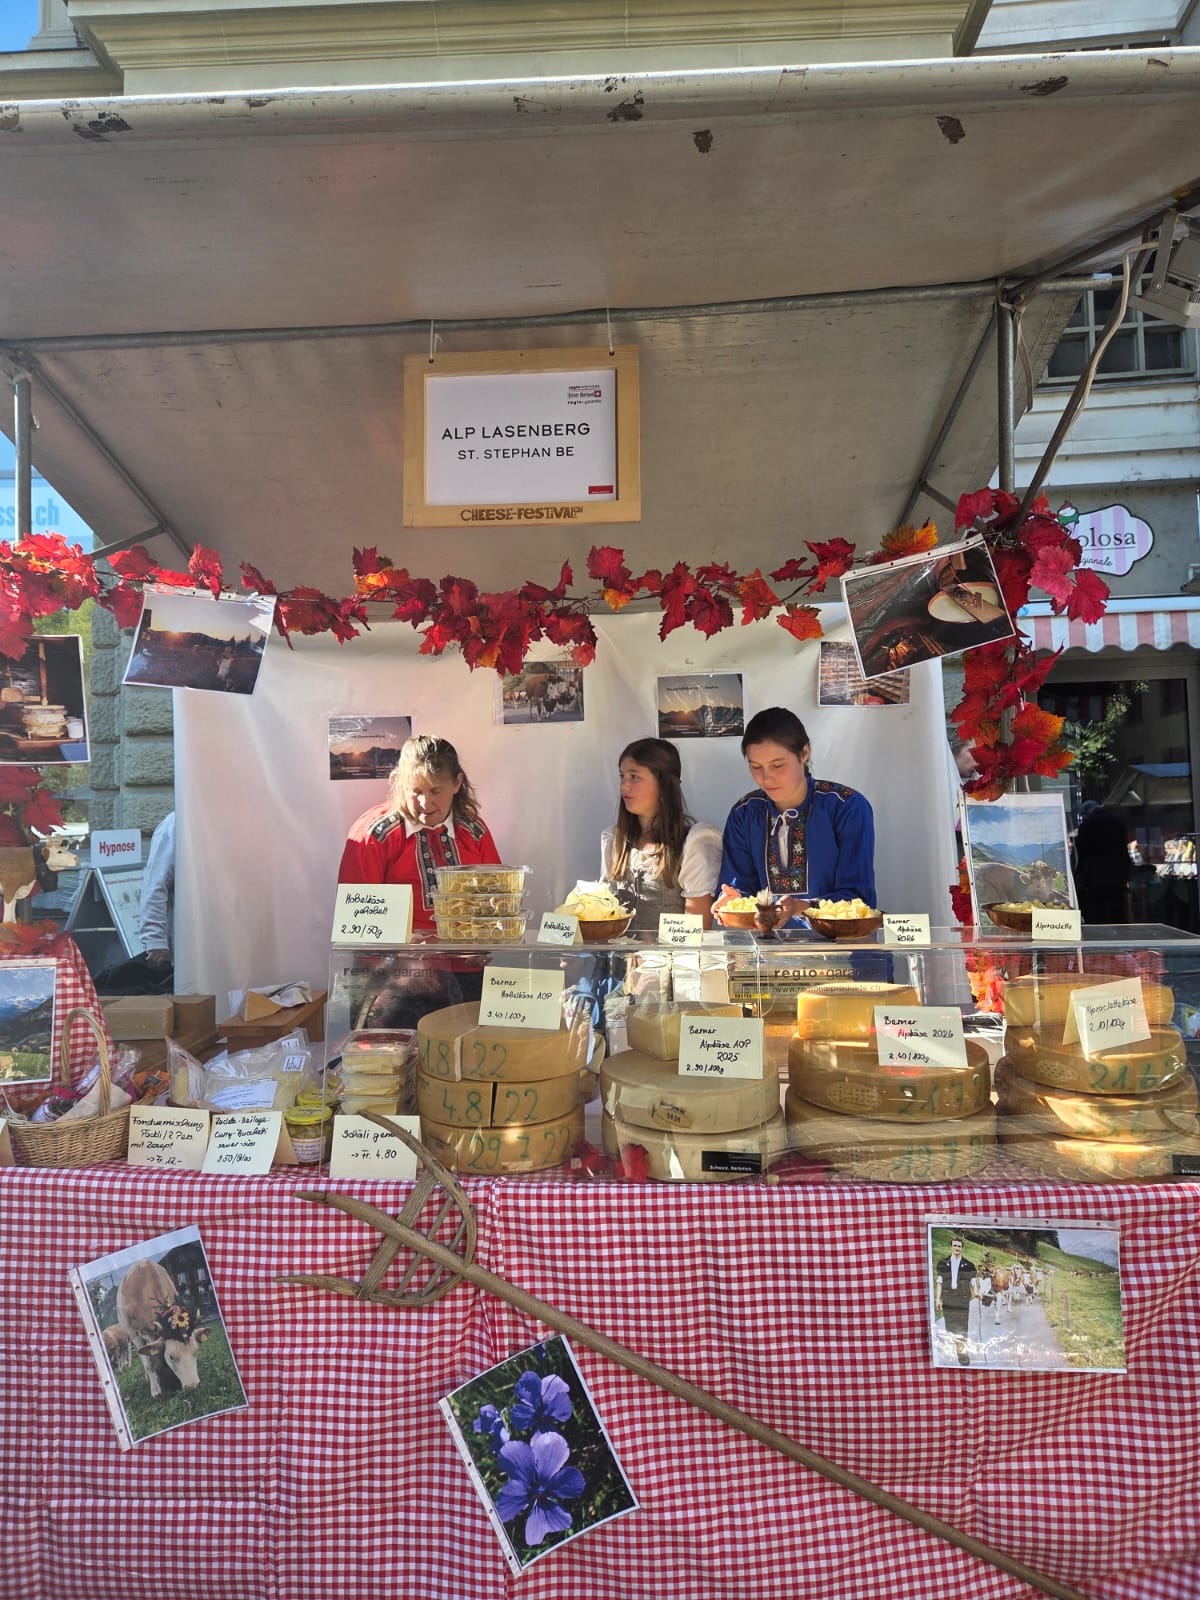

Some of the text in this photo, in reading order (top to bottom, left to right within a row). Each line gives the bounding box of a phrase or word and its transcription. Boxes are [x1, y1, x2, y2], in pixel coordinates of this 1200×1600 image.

[441, 423, 591, 440] ALP LASENBERG
[458, 446, 575, 460] ST. STEPHAN BE
[1077, 527, 1137, 548] olosa
[1080, 556, 1113, 568] gianale
[99, 841, 136, 856] Hypnose
[345, 892, 386, 905] Hobelkäse
[353, 906, 389, 918] gehobelt
[490, 978, 518, 986] Berner
[501, 990, 553, 1000] Hobelkäse AOP
[883, 1016, 918, 1026] Berner
[688, 1025, 718, 1035] Berner
[898, 1028, 954, 1040] Alpkäse 2026
[700, 1038, 752, 1052] Alpkäse AOP
[469, 1041, 508, 1078] 22
[717, 1051, 740, 1062] 2025
[342, 1129, 370, 1139] Schäli
[146, 1141, 174, 1152] Rezept
[376, 1150, 398, 1160] 4.80
